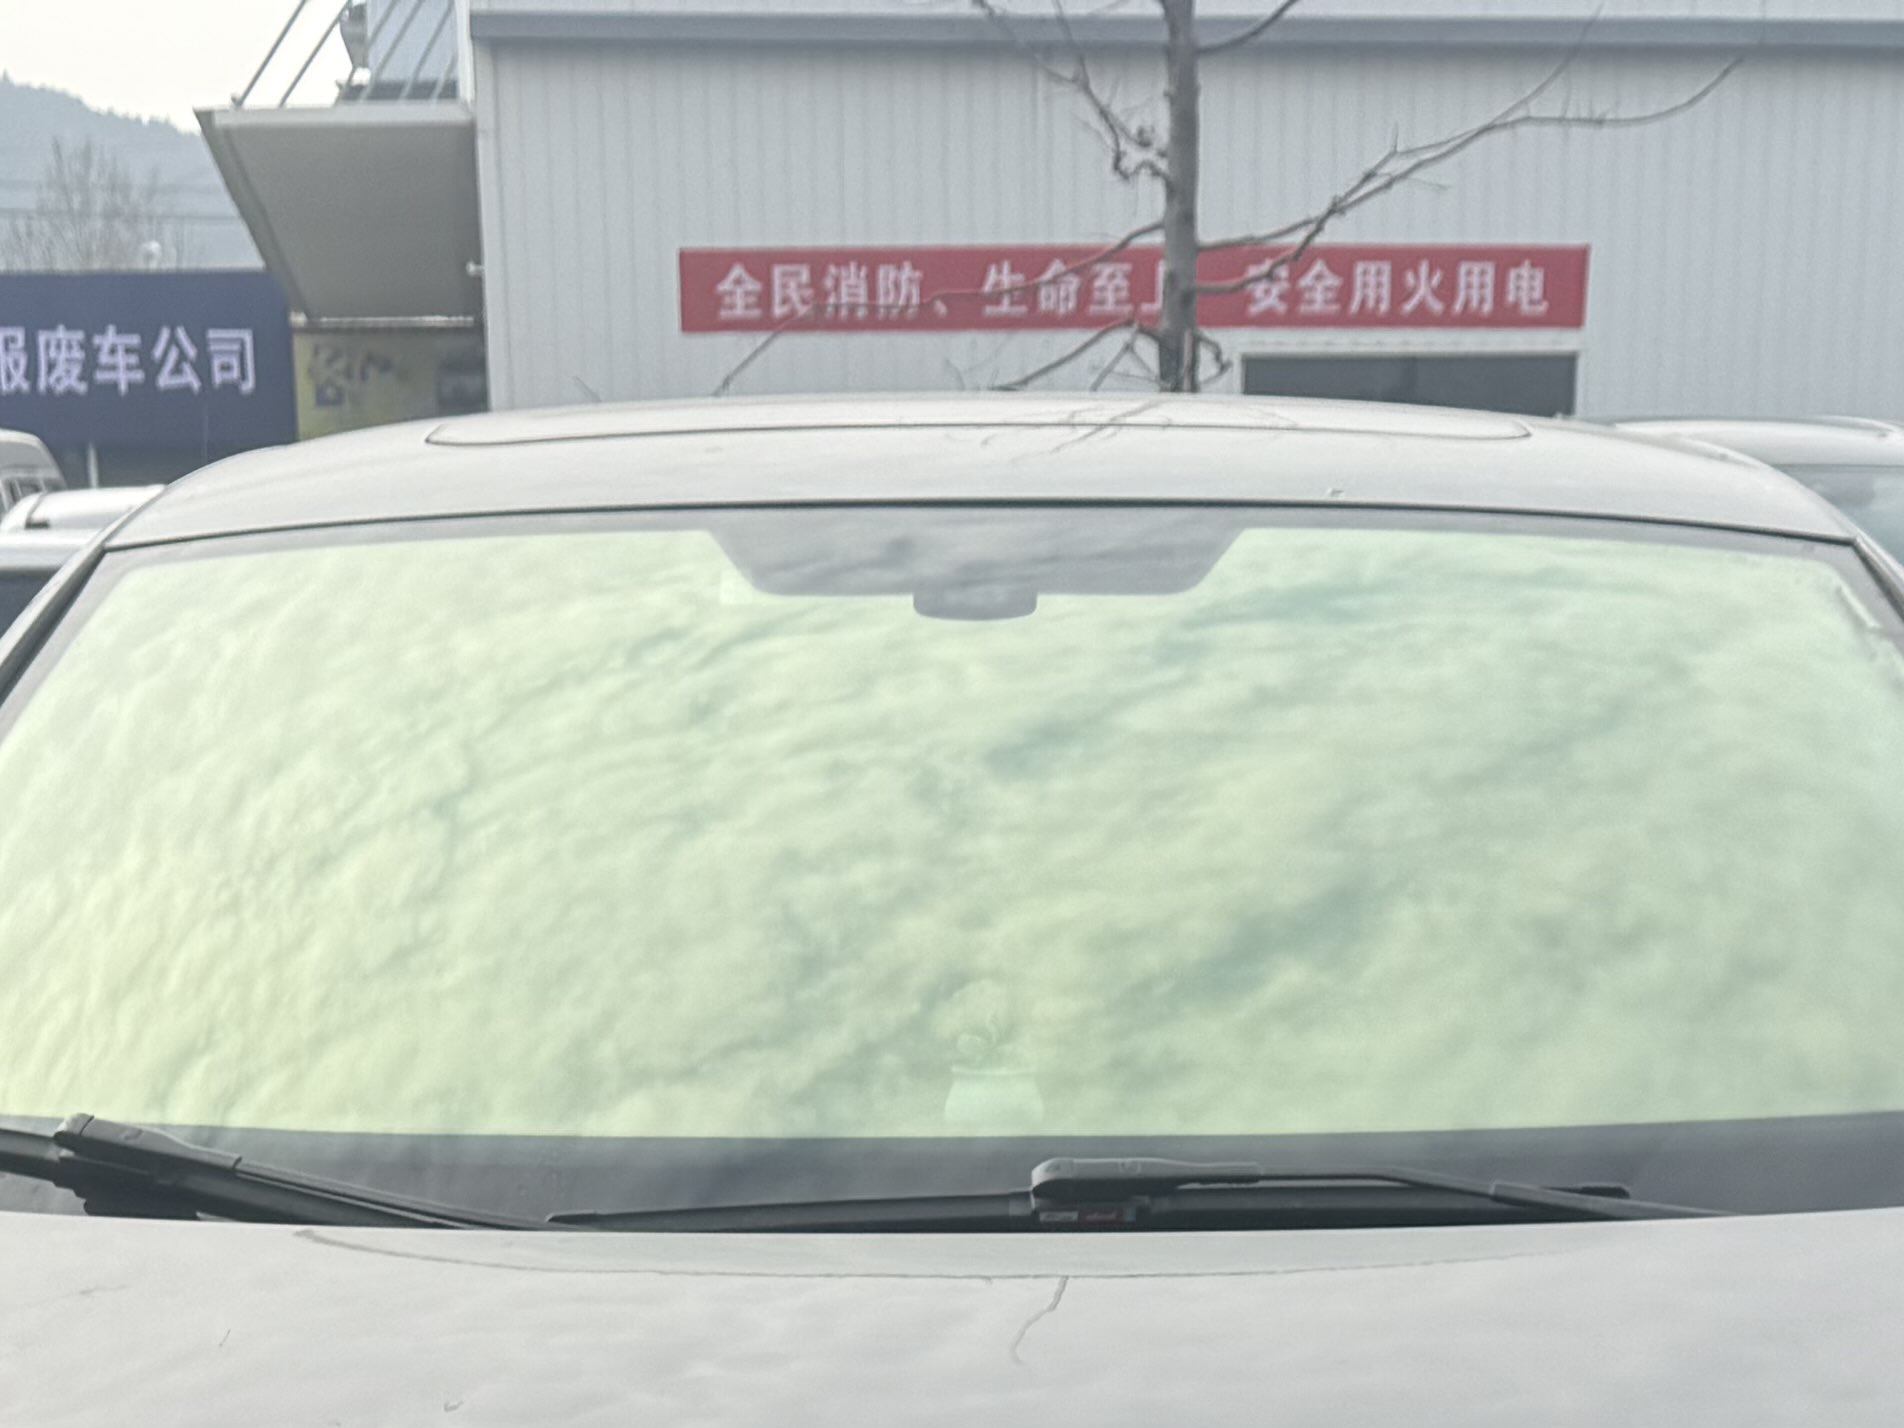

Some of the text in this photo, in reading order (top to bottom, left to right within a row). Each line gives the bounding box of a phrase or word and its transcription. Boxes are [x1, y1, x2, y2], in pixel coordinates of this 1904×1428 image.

[1246, 256, 1549, 317] 安全用火用电
